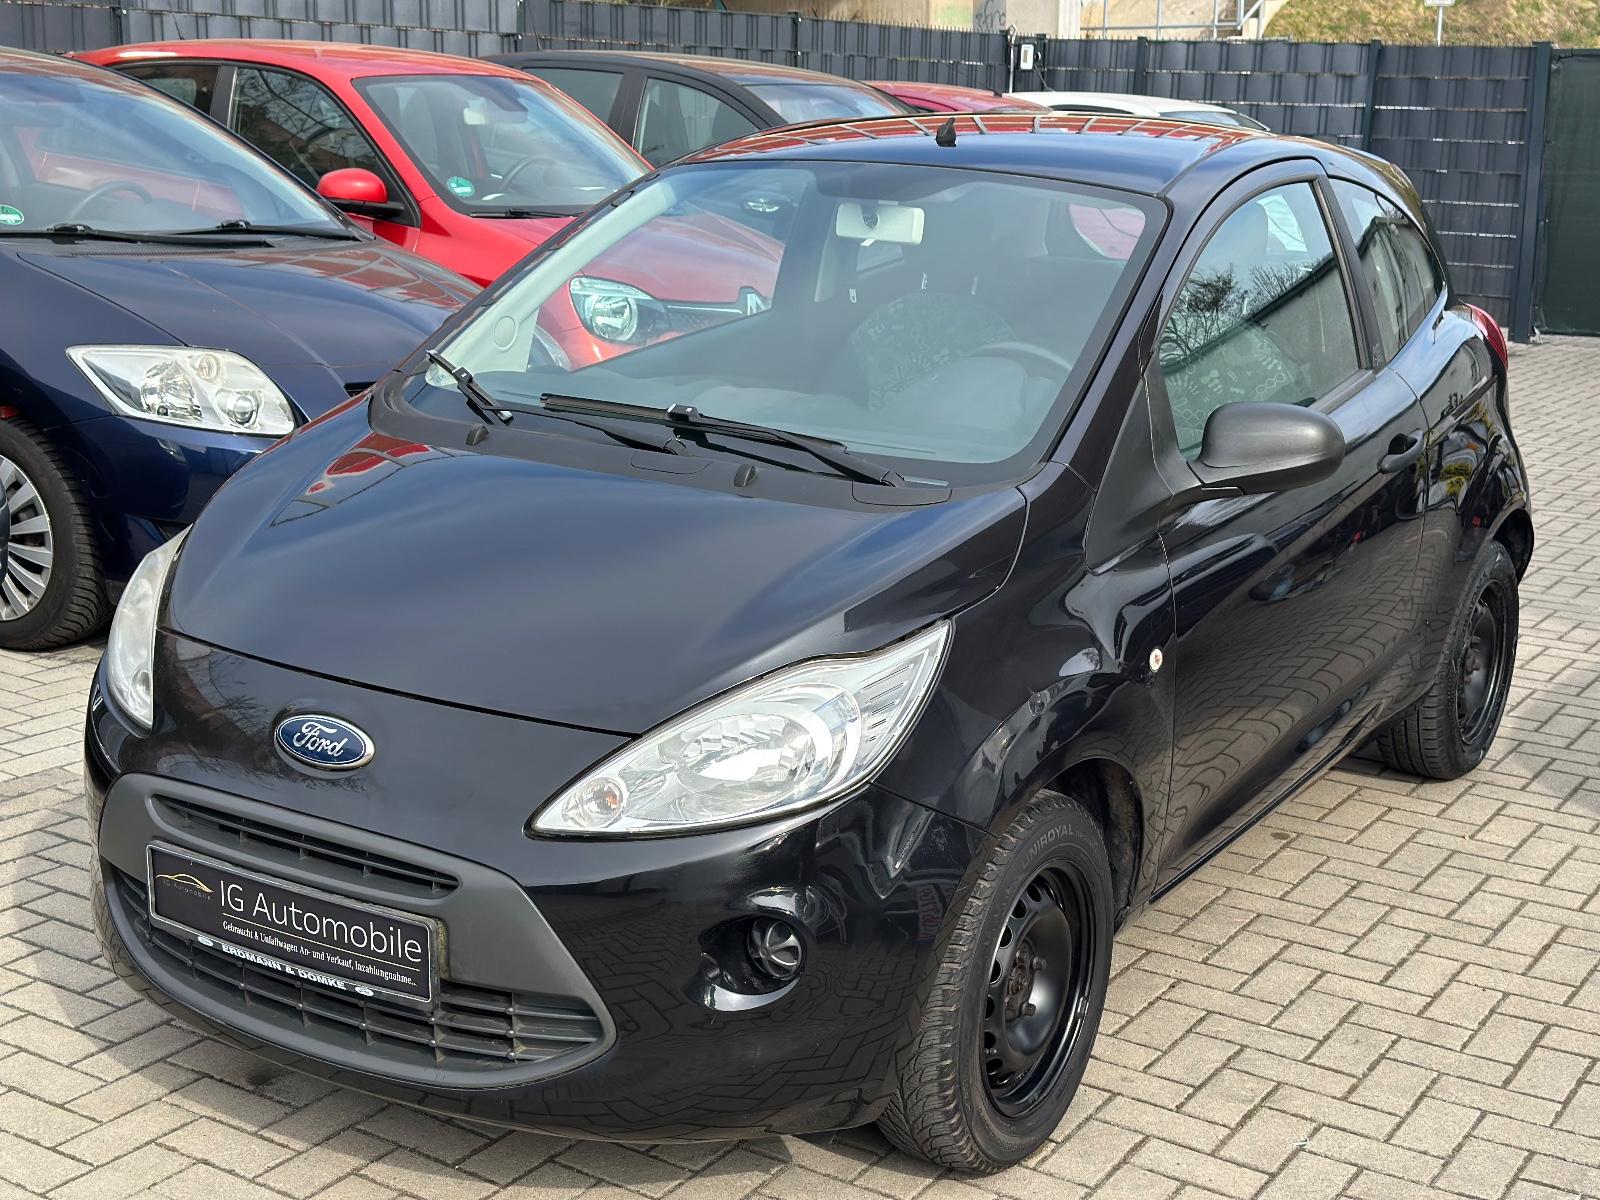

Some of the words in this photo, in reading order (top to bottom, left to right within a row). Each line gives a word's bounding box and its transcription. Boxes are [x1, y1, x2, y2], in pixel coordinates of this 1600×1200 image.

[293, 721, 349, 757] Ford
[220, 880, 244, 912] IG
[252, 892, 422, 962] Automobile
[222, 920, 254, 939] Gebraucht
[254, 931, 260, 941] &
[260, 932, 298, 953] Unfallwagen
[299, 944, 311, 956] An-
[312, 949, 325, 961] und
[326, 952, 354, 970] Verkauf,
[221, 943, 282, 971] ERDMANN
[297, 968, 347, 991] DOMKE
